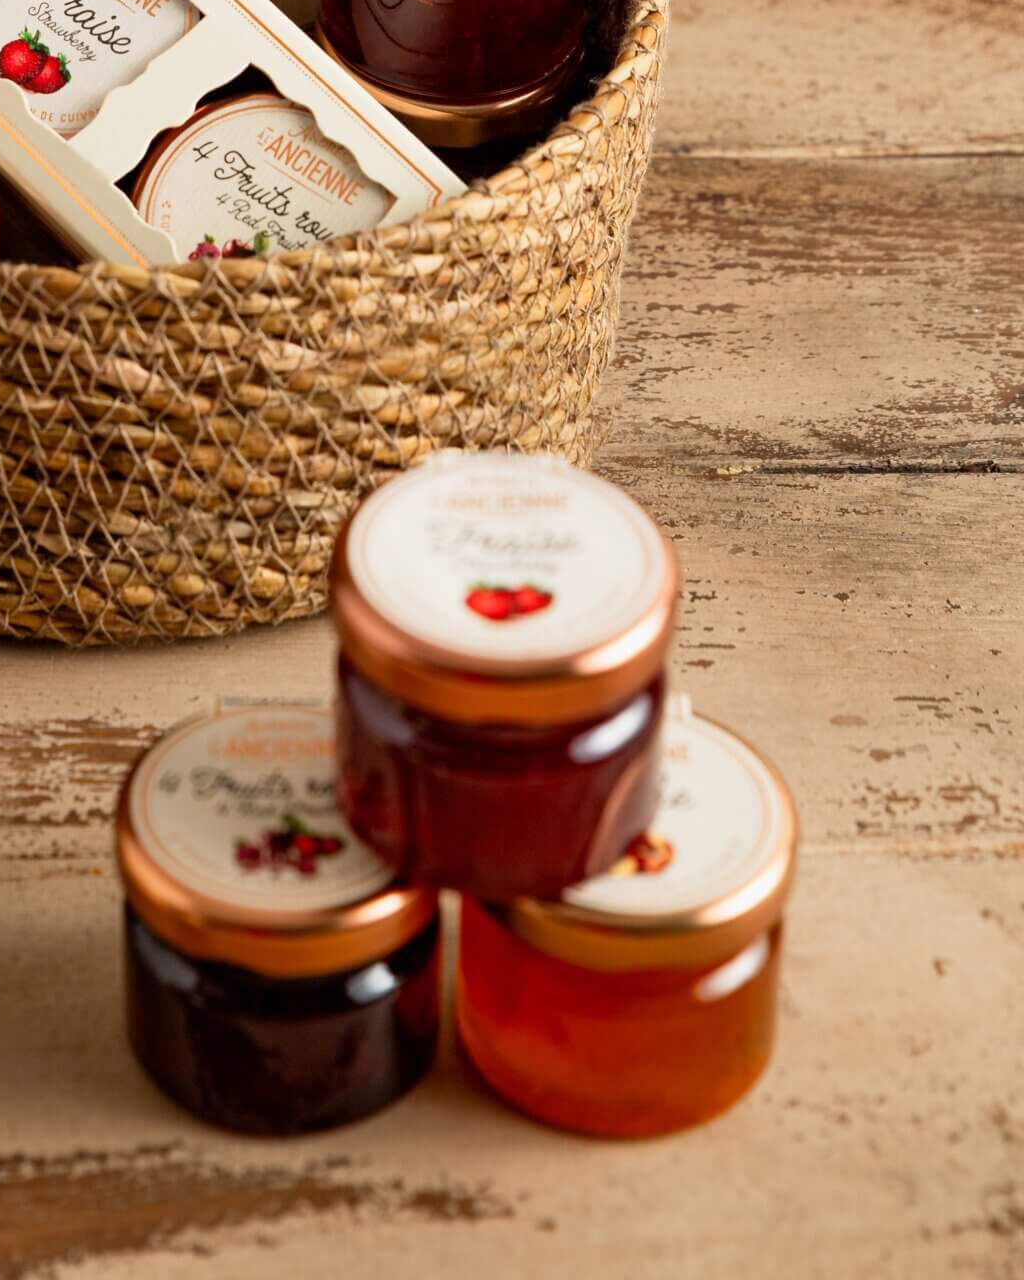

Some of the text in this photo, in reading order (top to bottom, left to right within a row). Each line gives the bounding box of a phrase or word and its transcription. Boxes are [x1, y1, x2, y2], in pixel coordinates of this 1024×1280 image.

[27, 1, 97, 64] Strawberry
[41, 111, 54, 122] DE
[192, 140, 220, 163] 4
[214, 150, 293, 217] Fruits
[227, 198, 260, 231] Red
